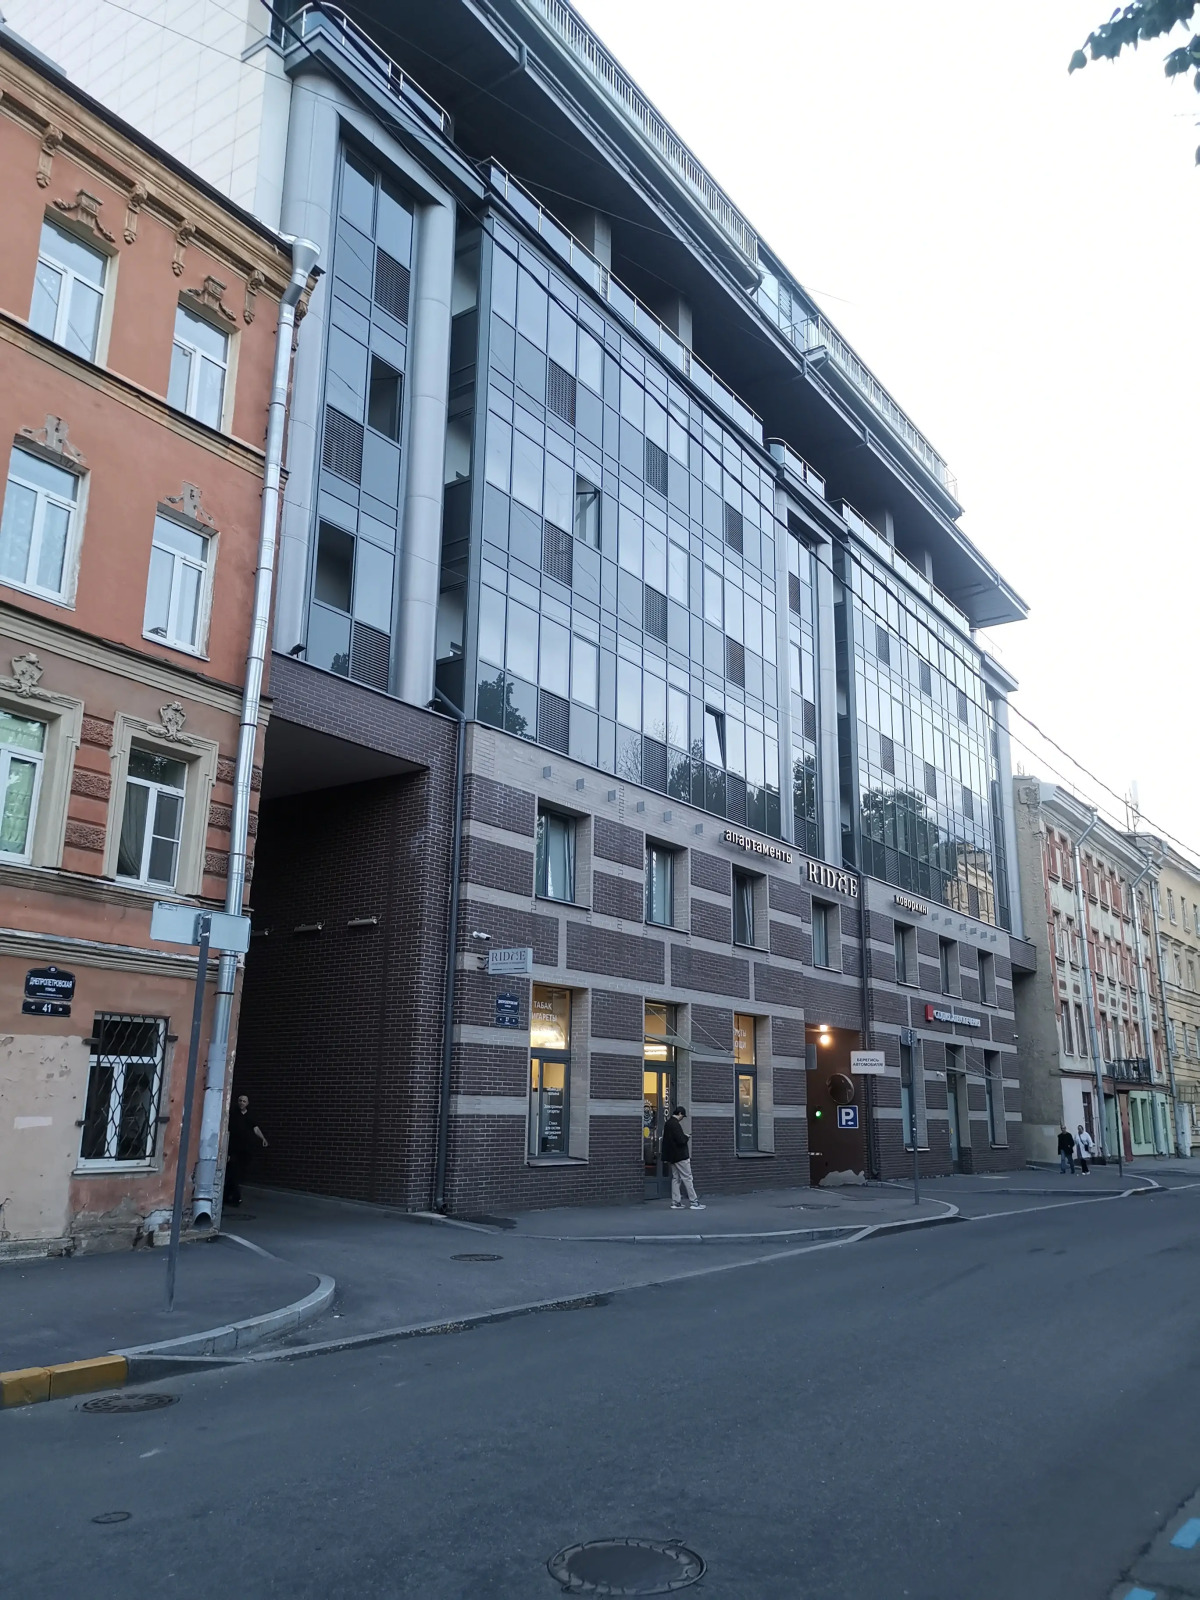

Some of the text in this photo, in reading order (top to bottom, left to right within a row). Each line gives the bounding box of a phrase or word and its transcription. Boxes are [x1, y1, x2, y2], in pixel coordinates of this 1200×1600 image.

[725, 829, 793, 864] апартаменты
[807, 861, 858, 898] RIDGE
[491, 950, 526, 962] RIDGE
[42, 1003, 51, 1013] 41
[533, 1000, 553, 1010] ТАБАК
[531, 1011, 557, 1022] ИГАРЕТЫ
[841, 1108, 854, 1125] P
